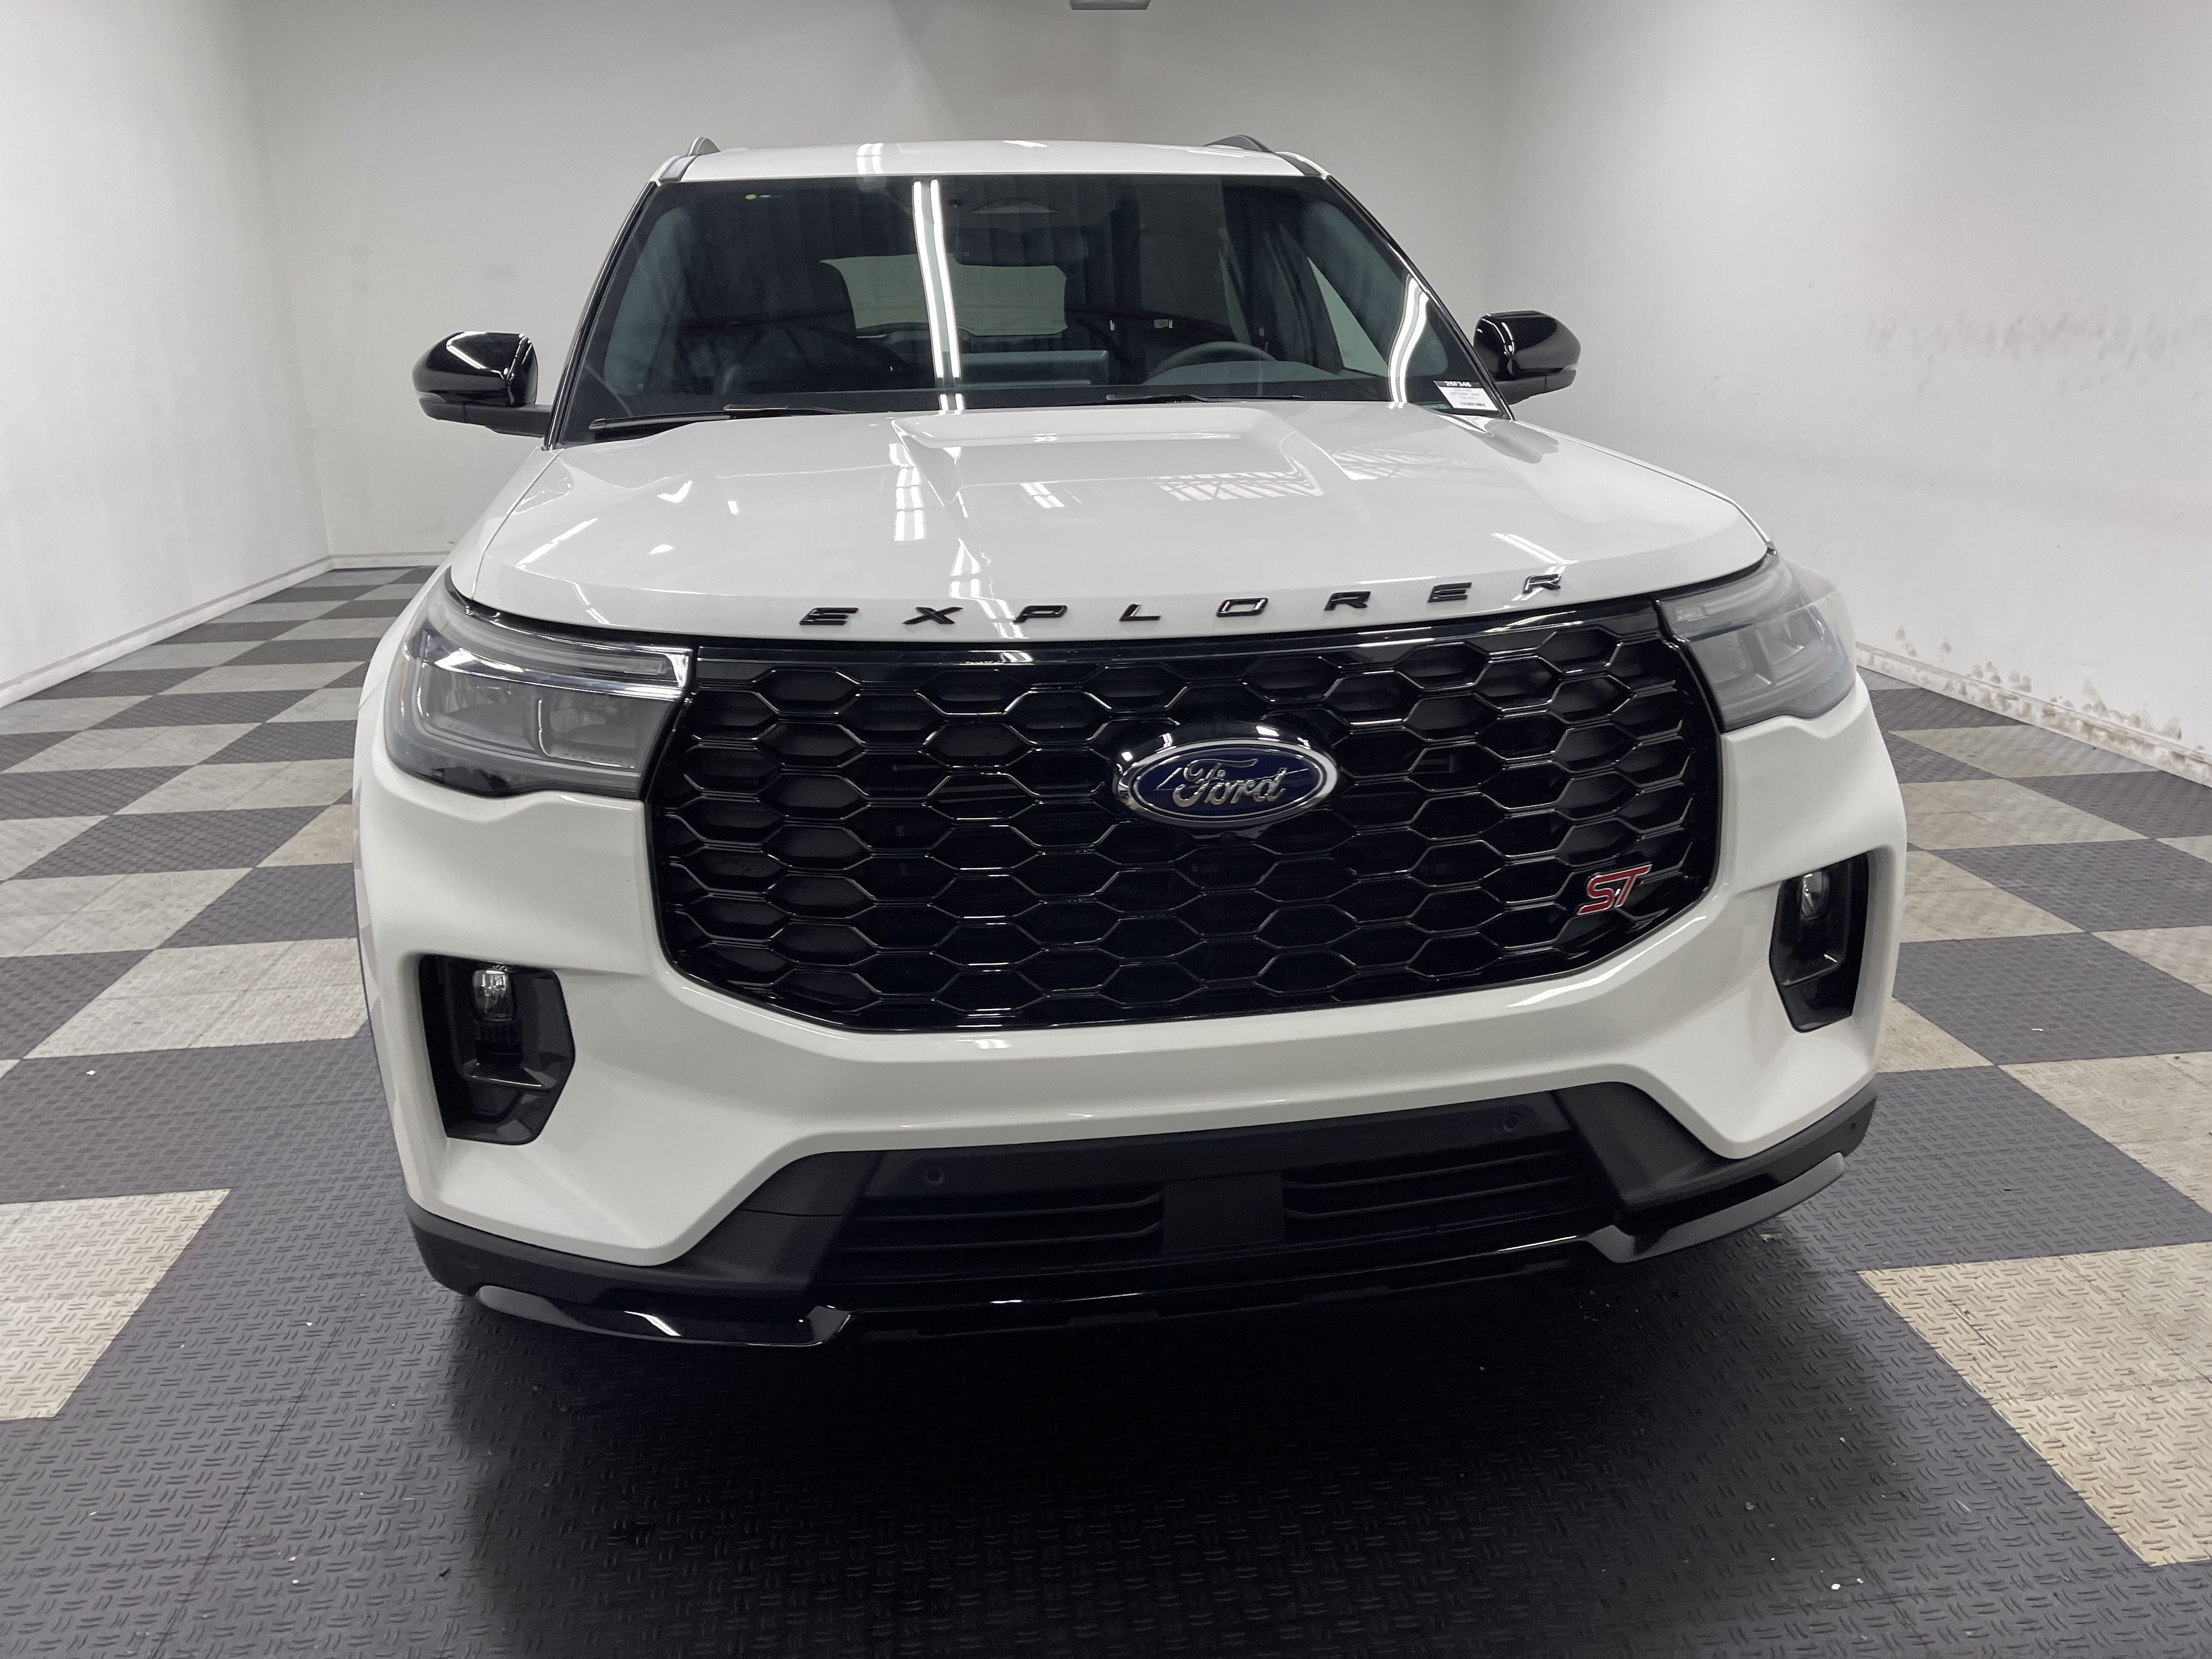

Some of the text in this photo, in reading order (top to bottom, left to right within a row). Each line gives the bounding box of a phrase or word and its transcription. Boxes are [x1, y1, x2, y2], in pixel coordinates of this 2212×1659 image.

[799, 573, 1562, 625] EXPLORER
[1155, 758, 1288, 808] Ford
[1577, 864, 1652, 915] ST
